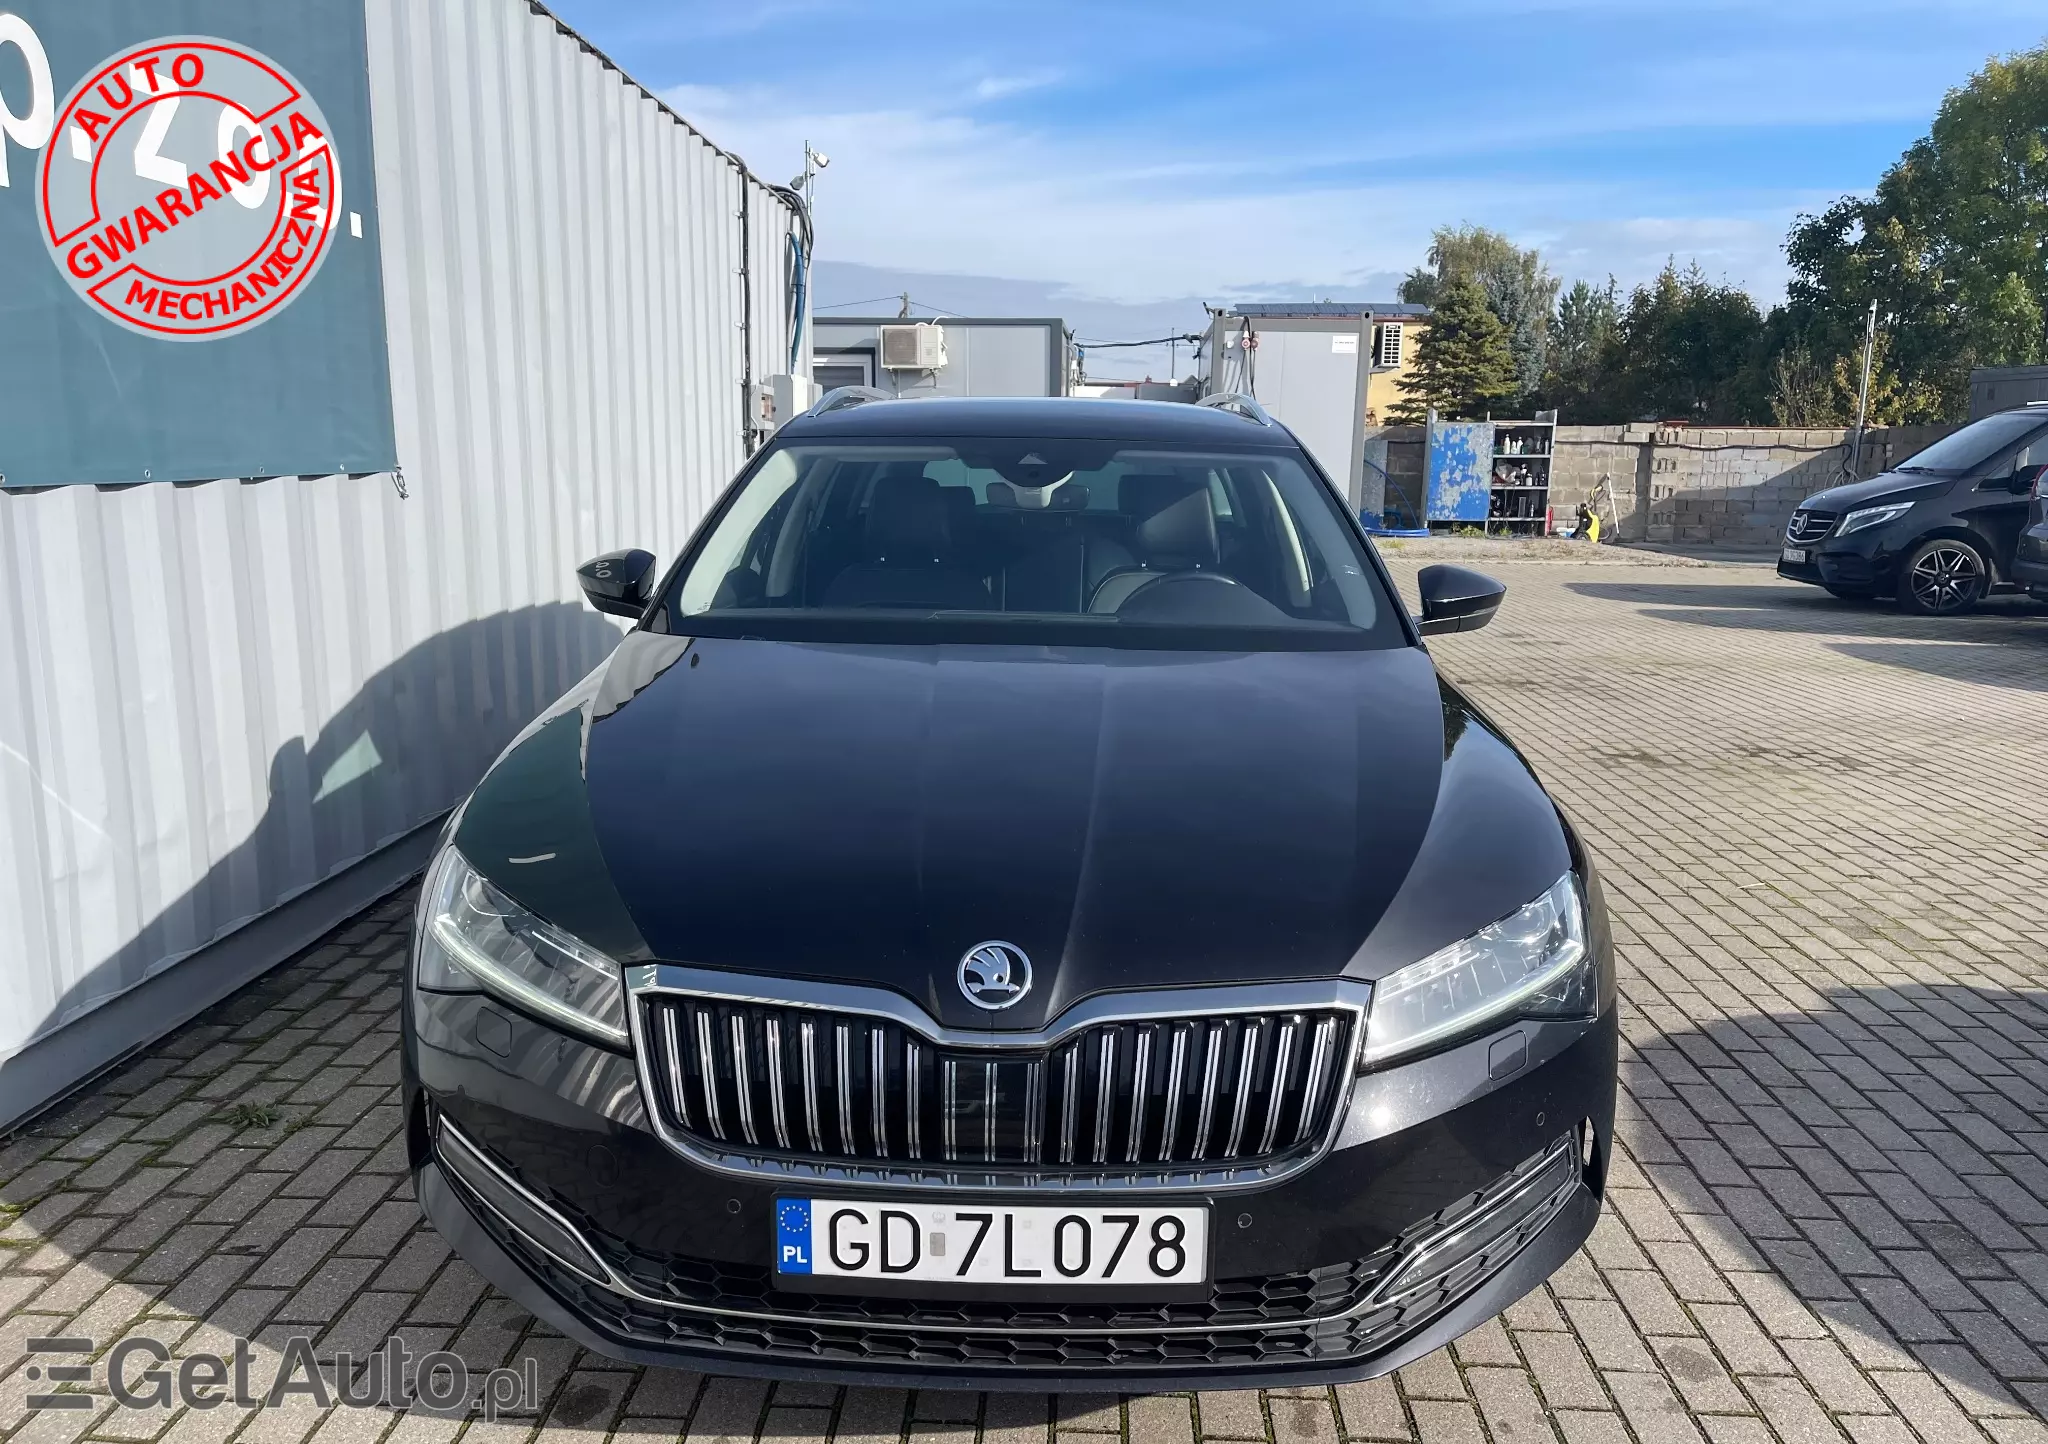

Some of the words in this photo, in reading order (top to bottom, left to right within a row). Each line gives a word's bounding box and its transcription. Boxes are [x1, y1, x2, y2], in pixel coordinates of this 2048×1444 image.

[783, 1245, 807, 1264] PL
[828, 1208, 921, 1273] GD
[955, 1213, 1187, 1279] 7L078
